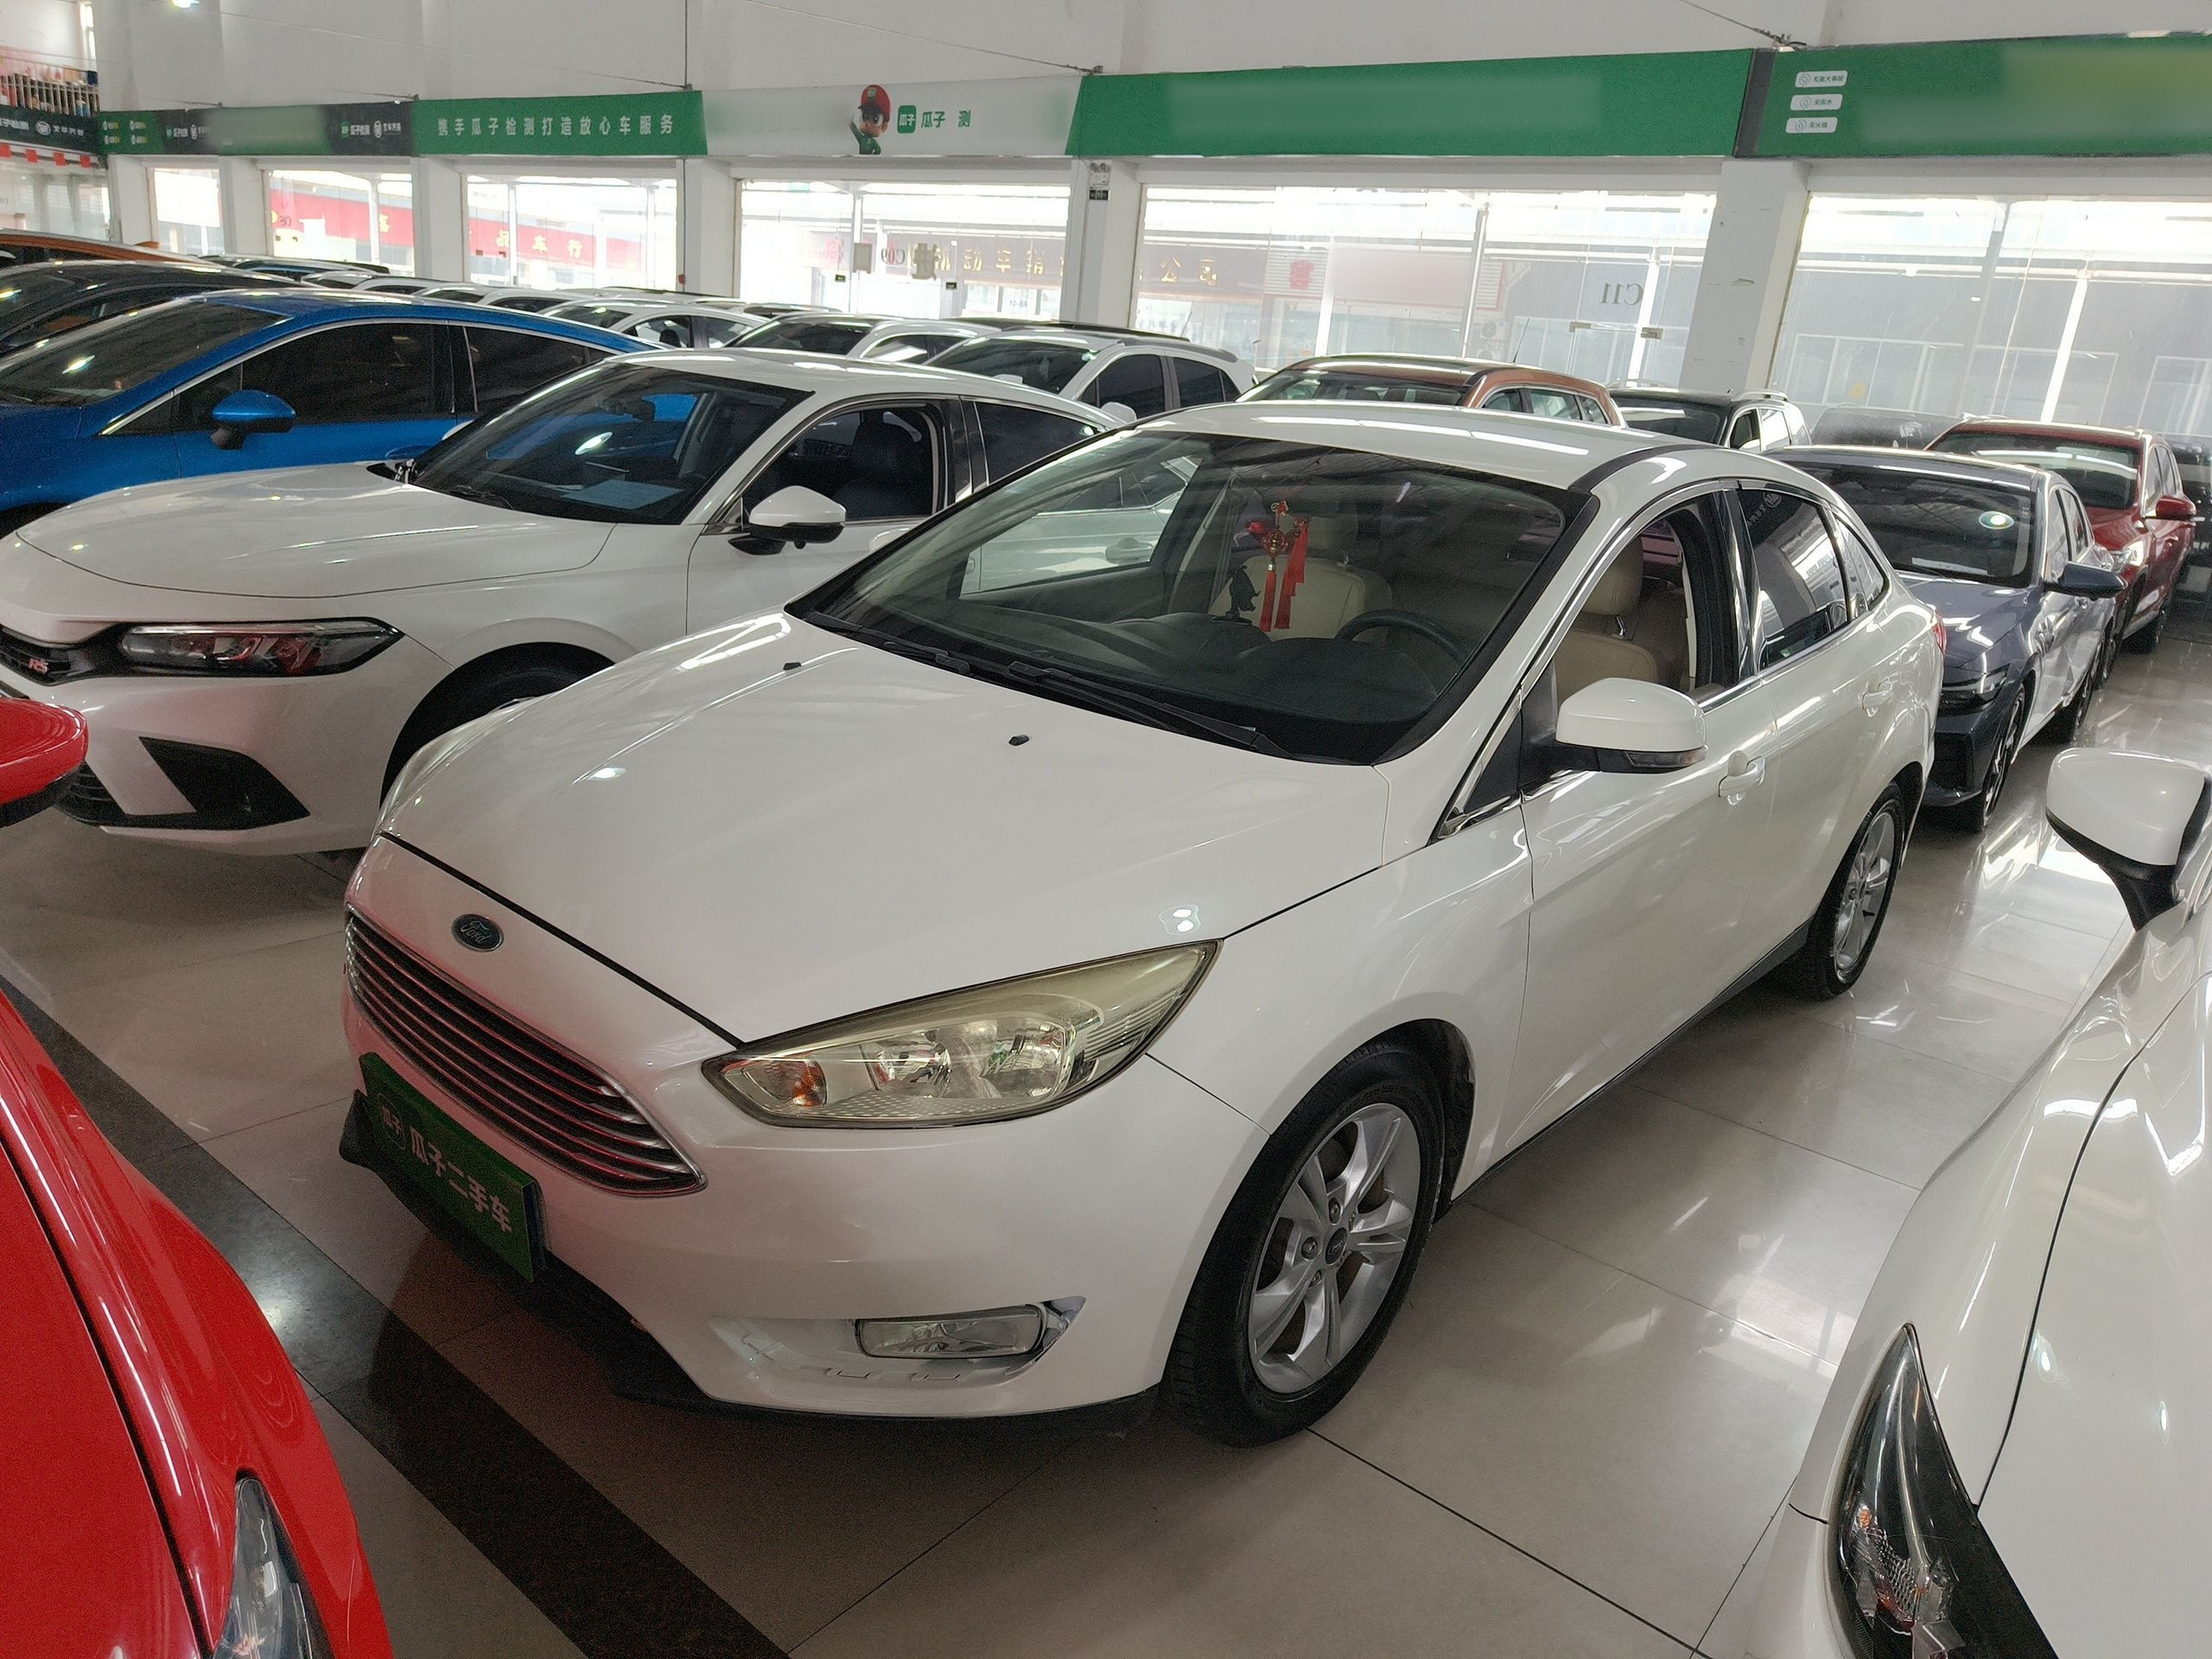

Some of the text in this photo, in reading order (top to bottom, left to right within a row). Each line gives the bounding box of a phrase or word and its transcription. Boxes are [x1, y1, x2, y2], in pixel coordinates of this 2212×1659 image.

[438, 114, 673, 137] 携手瓜子检测打造放心车服务
[921, 111, 945, 128] 瓜子
[957, 110, 971, 127] 测
[29, 658, 49, 675] RS
[410, 1125, 512, 1233] 瓜子二手车
